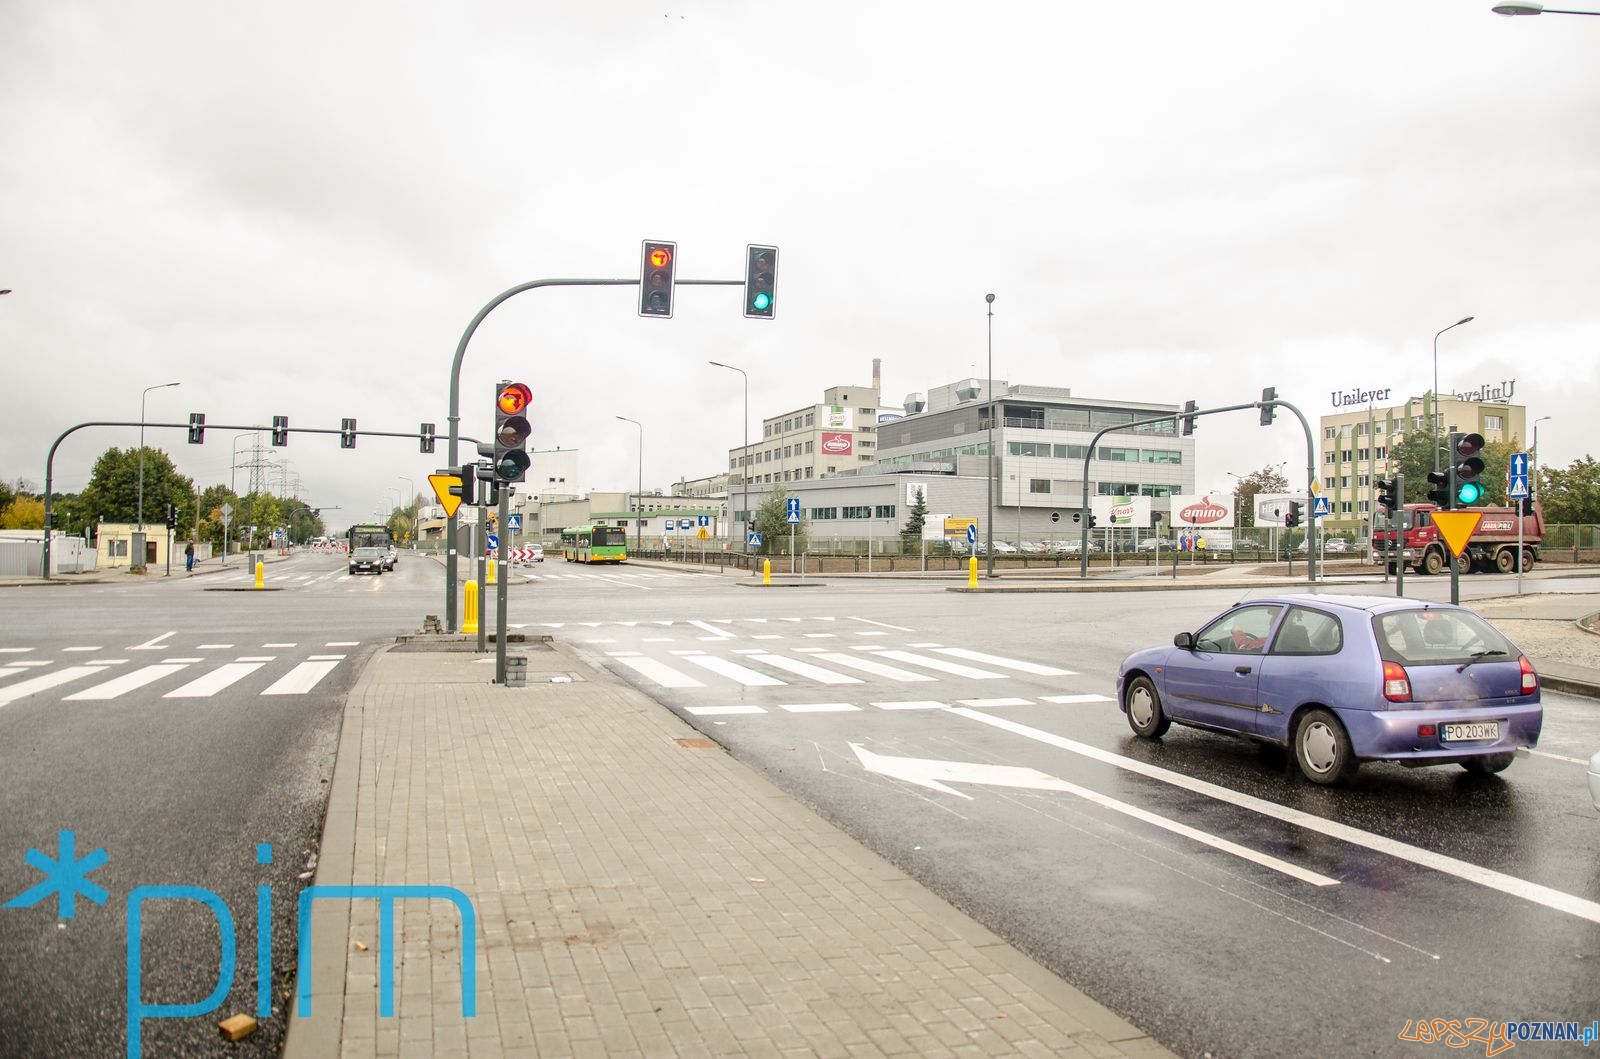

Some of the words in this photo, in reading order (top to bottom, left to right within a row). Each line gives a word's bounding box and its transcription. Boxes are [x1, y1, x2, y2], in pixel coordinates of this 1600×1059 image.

[1331, 388, 1391, 407] Unilever
[1183, 509, 1225, 518] amino
[1447, 726, 1463, 739] PO
[1466, 723, 1497, 738] 203WK
